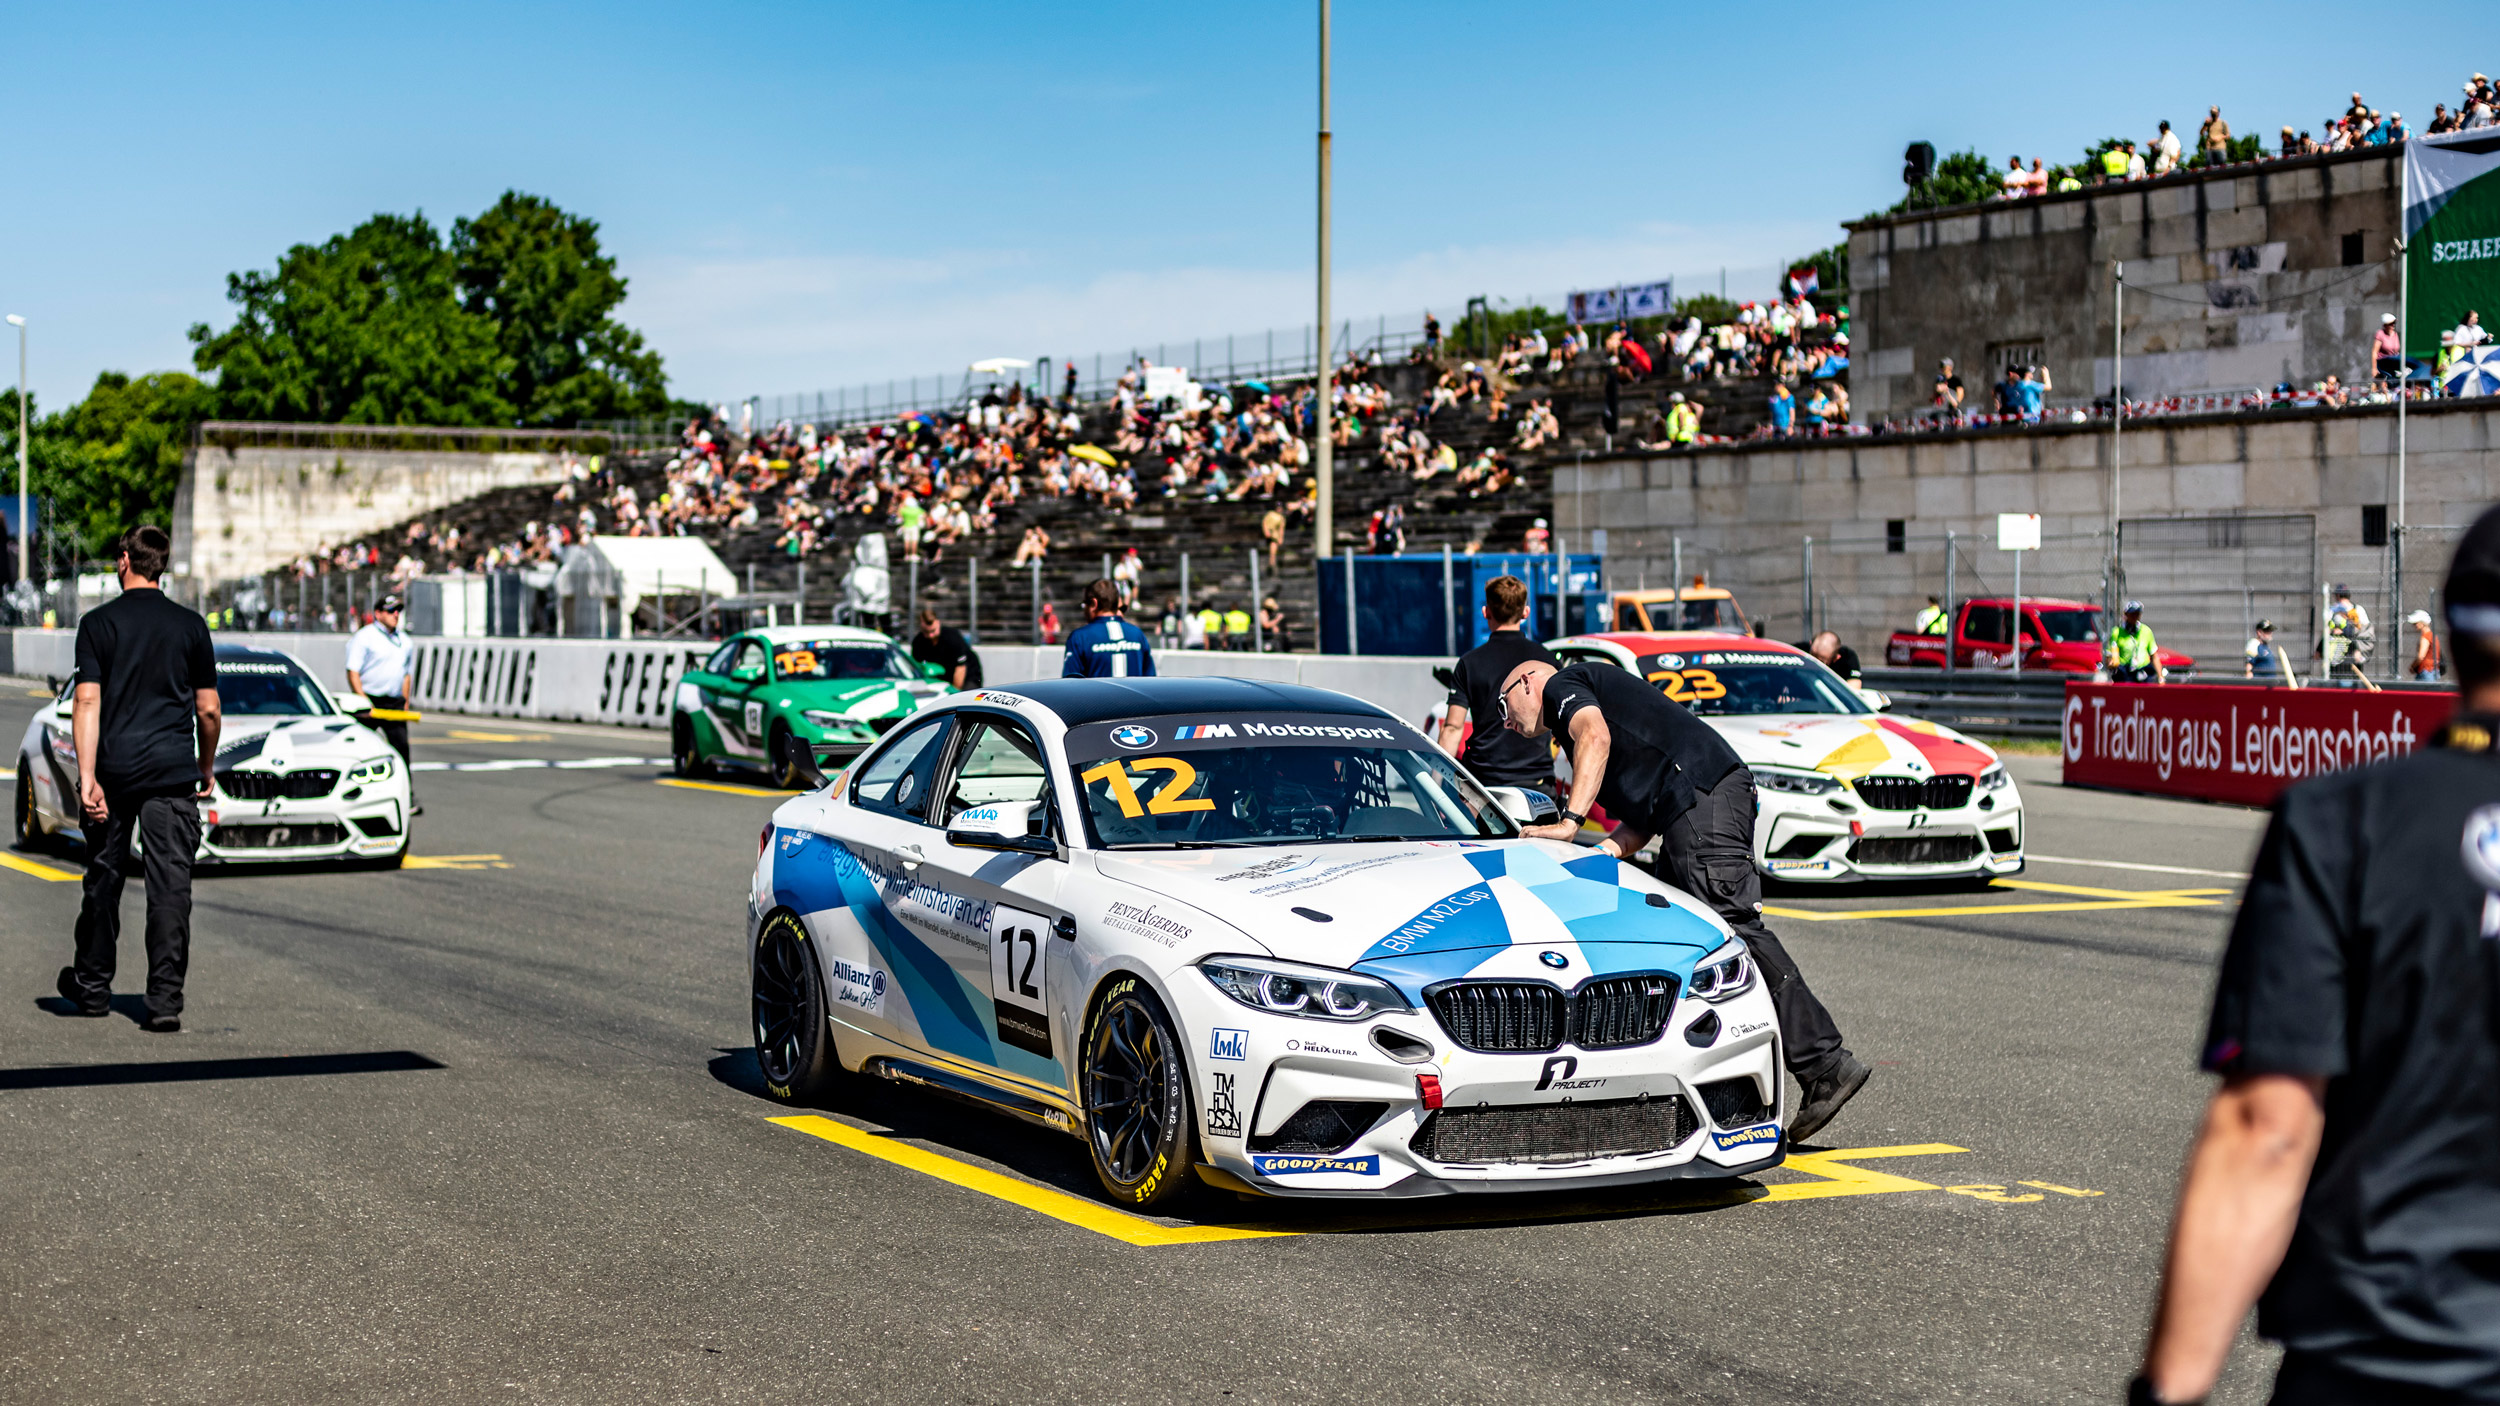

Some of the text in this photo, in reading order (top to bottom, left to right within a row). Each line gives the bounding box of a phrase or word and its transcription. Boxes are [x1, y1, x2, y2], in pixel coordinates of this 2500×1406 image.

[1092, 640, 1142, 653] GOODYEAR
[775, 650, 818, 674] 13
[1725, 653, 1805, 666] Motorsport
[1647, 669, 1727, 702] 23
[1242, 723, 1395, 741] Motorsport
[2091, 696, 2173, 781] Trading
[2178, 718, 2222, 771] aus
[2230, 704, 2416, 778] Leidenschaft
[1081, 757, 1216, 819] 12
[817, 842, 992, 932] energyhub-wilhelmshaven.de
[1102, 916, 1177, 949] METALLVEREDELUNG
[1381, 889, 1491, 953] BMW M2 Cup
[833, 960, 871, 987] Allianz
[1001, 925, 1039, 1000] 12
[1304, 1045, 1358, 1056] HELIX ULTRA
[1169, 1062, 1178, 1083] SET
[1552, 1078, 1607, 1090] PROJECT 1
[1718, 1126, 1776, 1148] GOODYEAR
[1135, 1152, 1168, 1203] EAGLE
[1265, 1158, 1369, 1172] GOODYEAR
